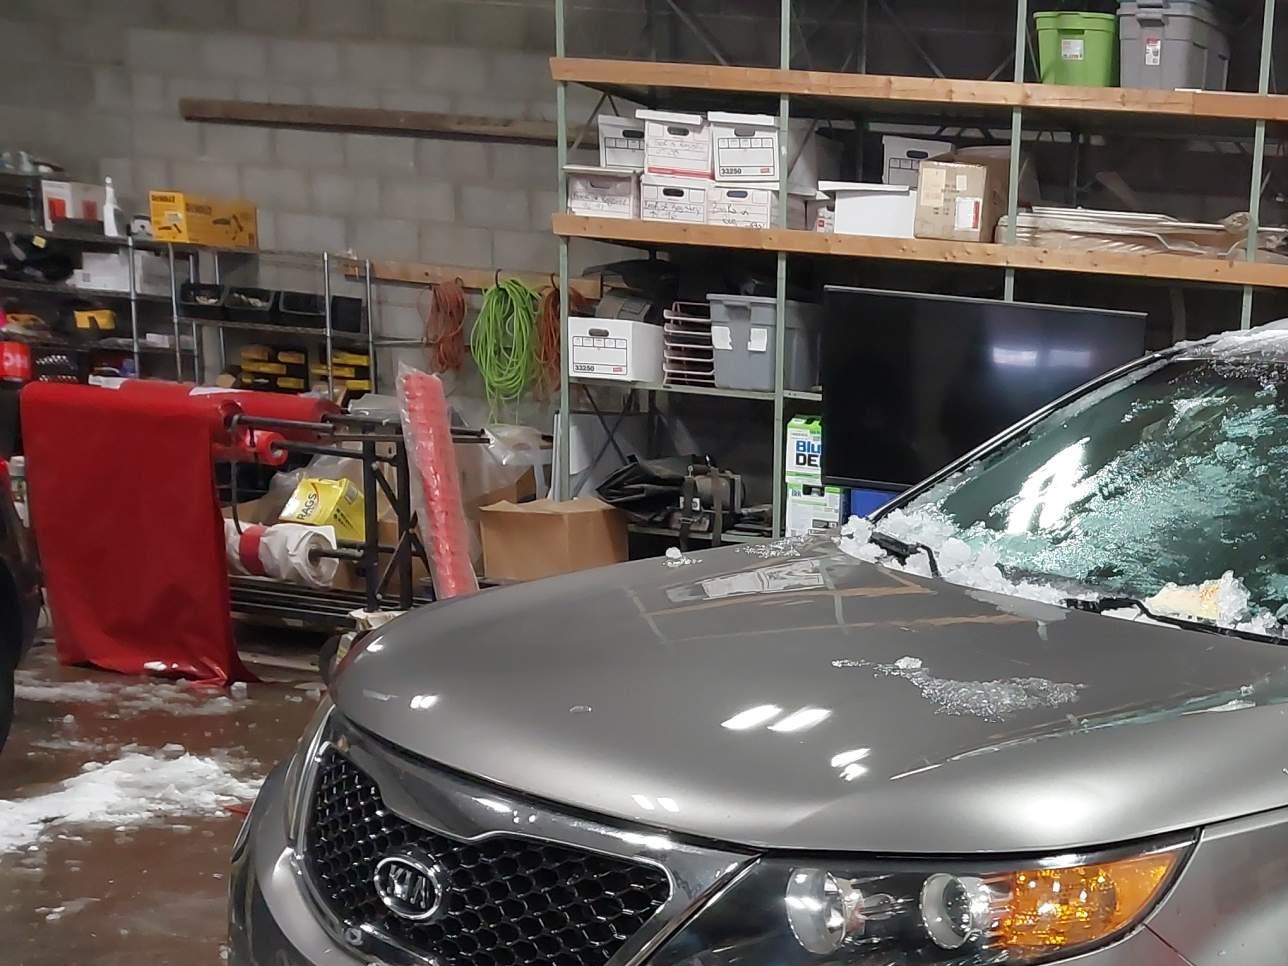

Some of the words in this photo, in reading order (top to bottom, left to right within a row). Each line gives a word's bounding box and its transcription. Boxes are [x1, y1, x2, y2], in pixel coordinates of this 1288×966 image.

[721, 167, 742, 175] 33250
[296, 493, 317, 520] RAGS
[387, 863, 430, 909] KIA
